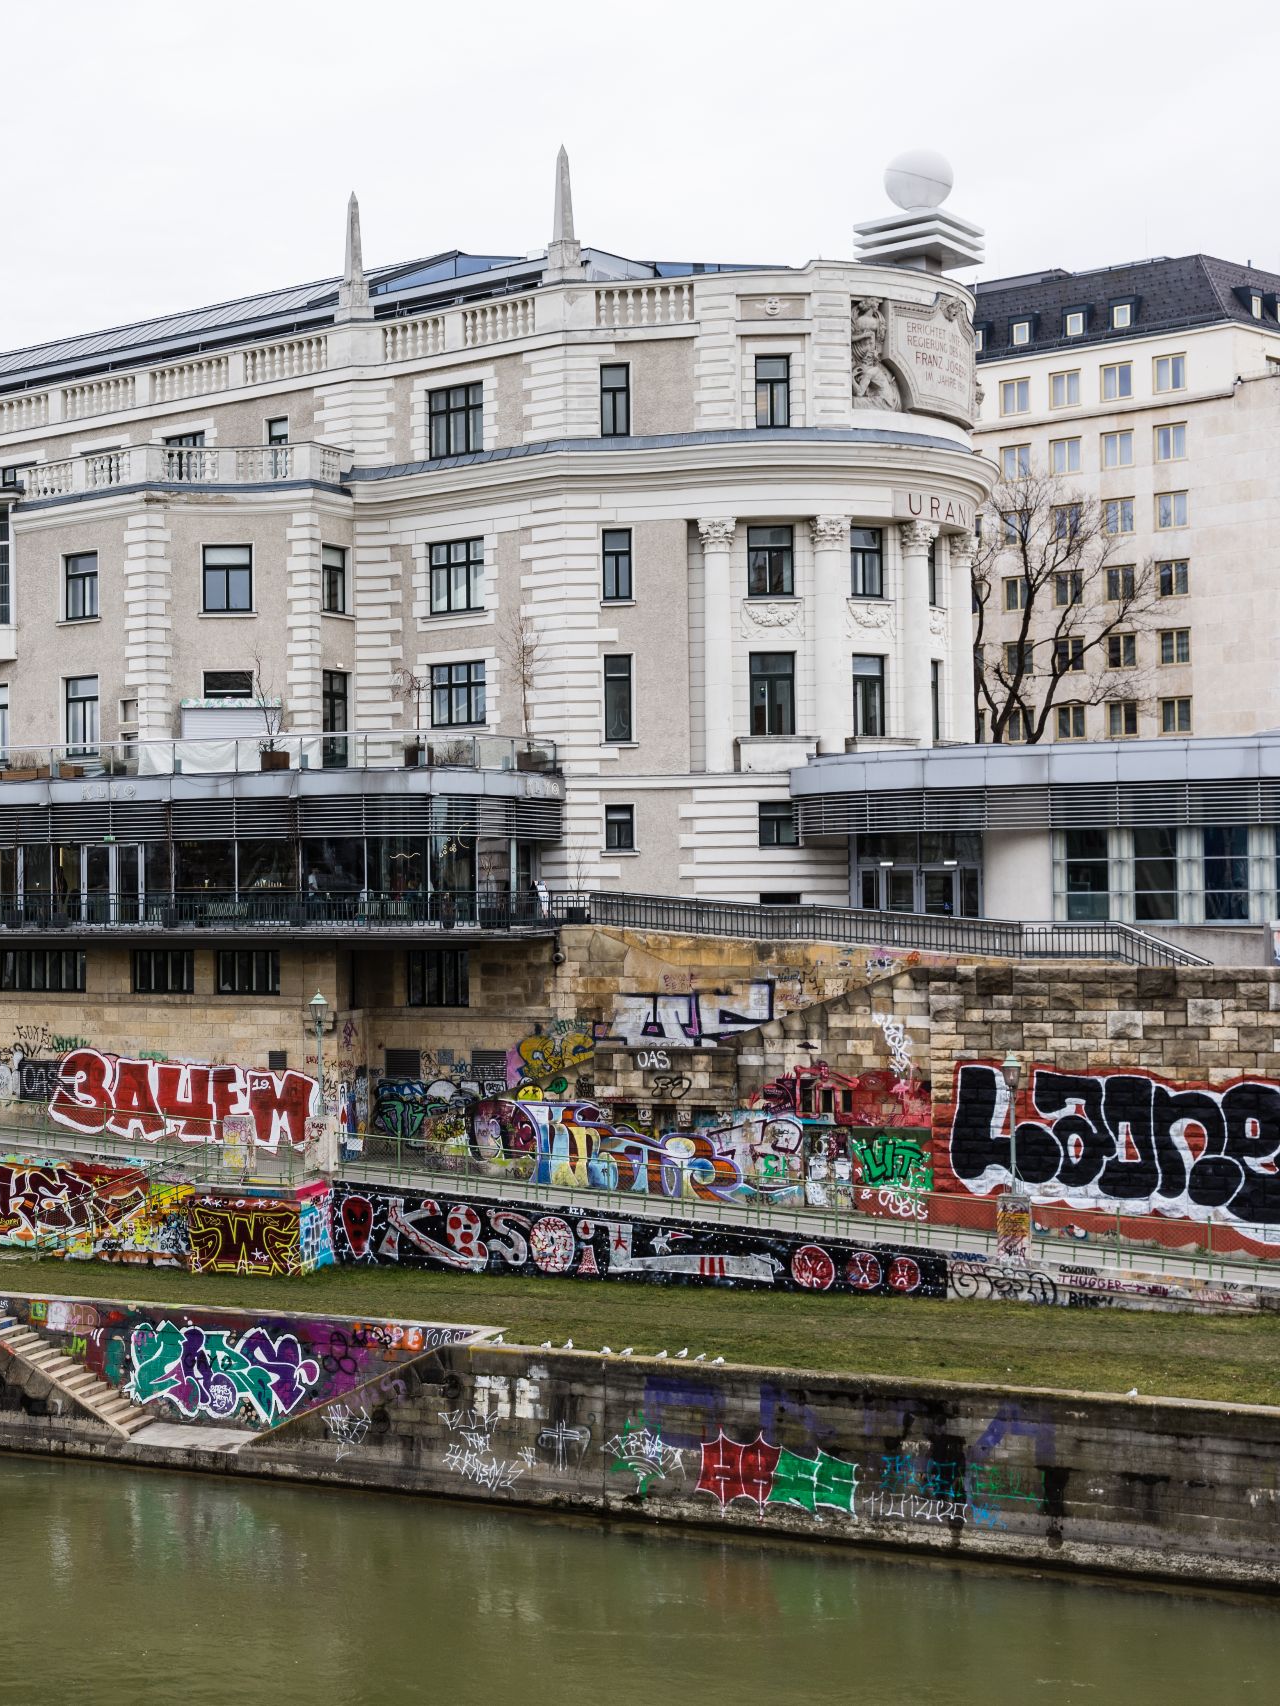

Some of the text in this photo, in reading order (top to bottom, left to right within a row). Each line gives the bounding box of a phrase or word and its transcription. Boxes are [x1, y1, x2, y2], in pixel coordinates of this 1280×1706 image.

[906, 321, 946, 340] ERRICHTET
[906, 335, 948, 354] REGIERUNG
[915, 351, 943, 370] FRANZ
[925, 371, 934, 382] IM
[81, 783, 137, 801] KLYO
[637, 1050, 670, 1070] OAS
